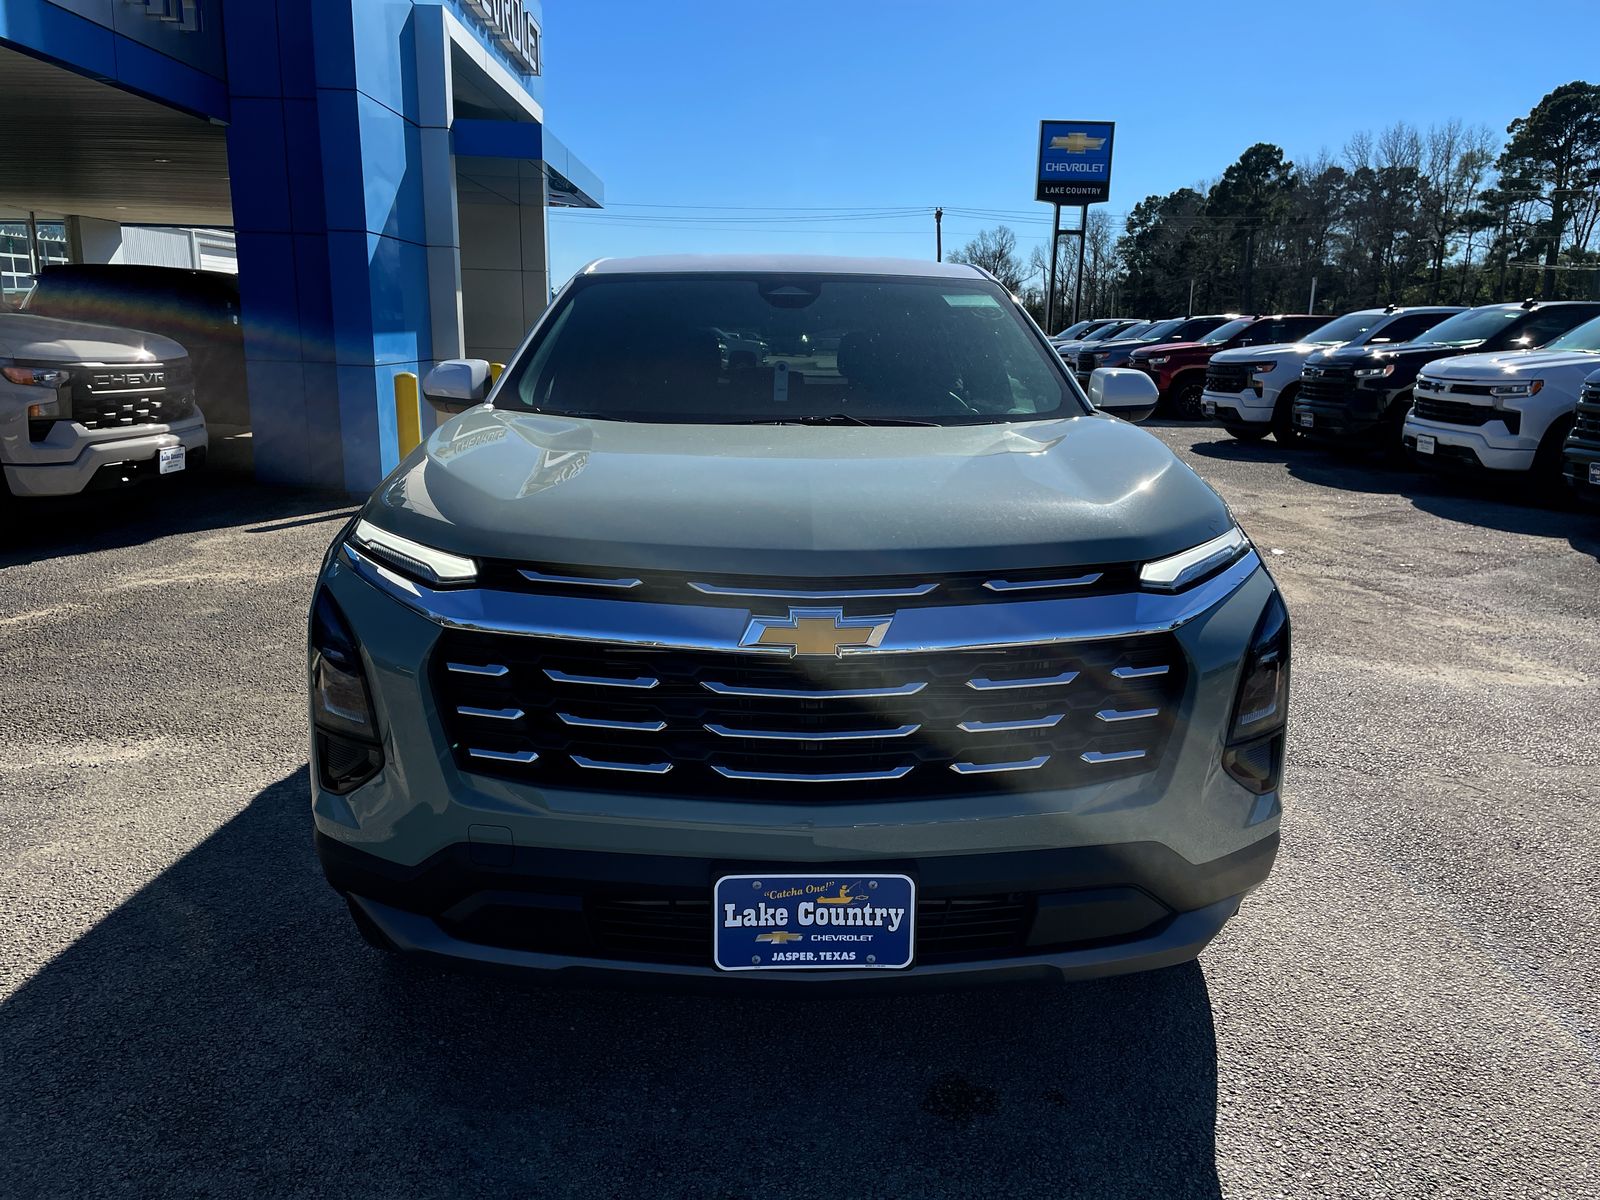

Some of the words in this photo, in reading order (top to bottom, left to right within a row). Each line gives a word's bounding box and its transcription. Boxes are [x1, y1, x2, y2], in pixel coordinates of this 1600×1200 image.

[1045, 162, 1105, 173] CHEVROLET
[1045, 186, 1065, 194] LAKE
[1065, 186, 1101, 195] COUNTRY
[93, 372, 165, 385] CHEVR
[724, 902, 789, 928] Lake
[797, 901, 905, 932] Country
[811, 934, 874, 942] CHEVROLET
[771, 952, 817, 961] JASPER,
[819, 951, 856, 961] TEXAS
